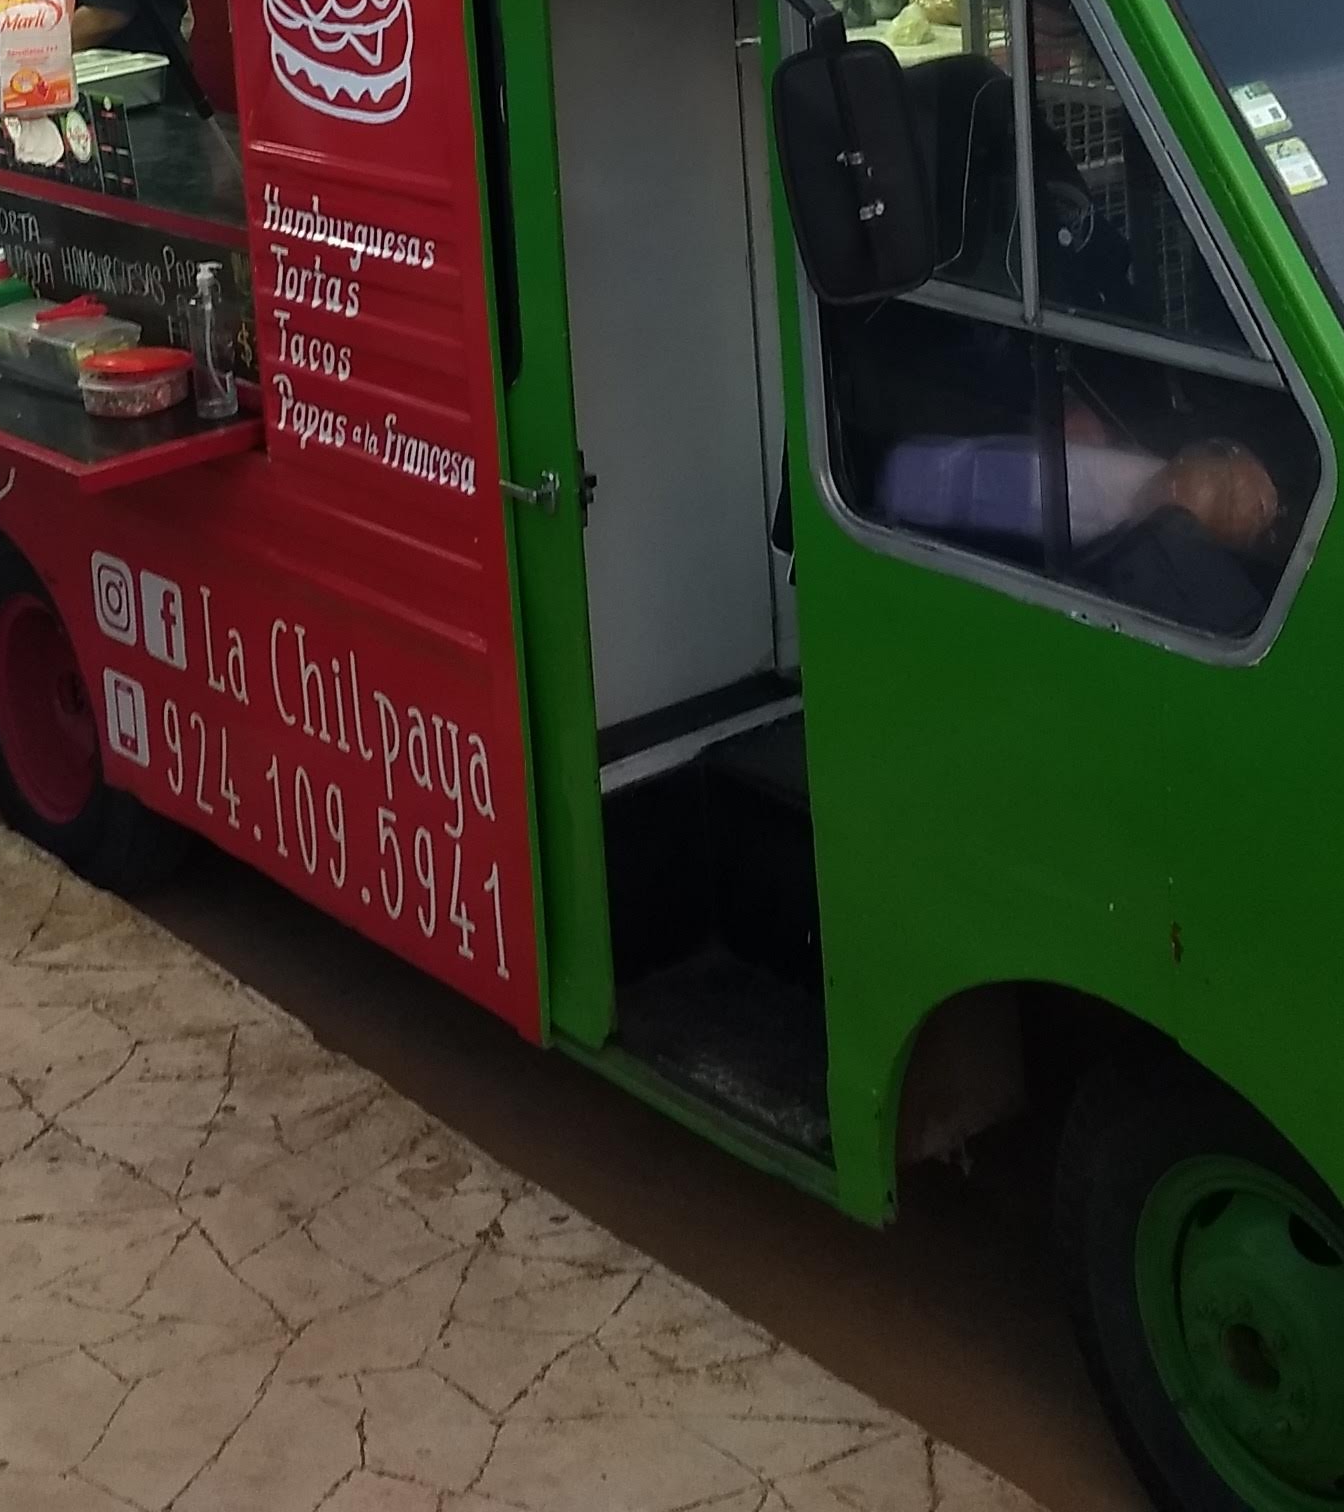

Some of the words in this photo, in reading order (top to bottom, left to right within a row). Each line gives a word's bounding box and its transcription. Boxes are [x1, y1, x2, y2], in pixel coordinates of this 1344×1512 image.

[263, 183, 436, 272] Hamburguesas
[270, 243, 361, 318] Tortas
[273, 309, 352, 382] Tacos
[272, 373, 348, 450] Papas
[352, 425, 361, 444] a
[364, 420, 379, 456] la
[199, 585, 250, 706] La
[270, 617, 496, 839] Chilpaya
[163, 698, 511, 981] 924.109.5941
